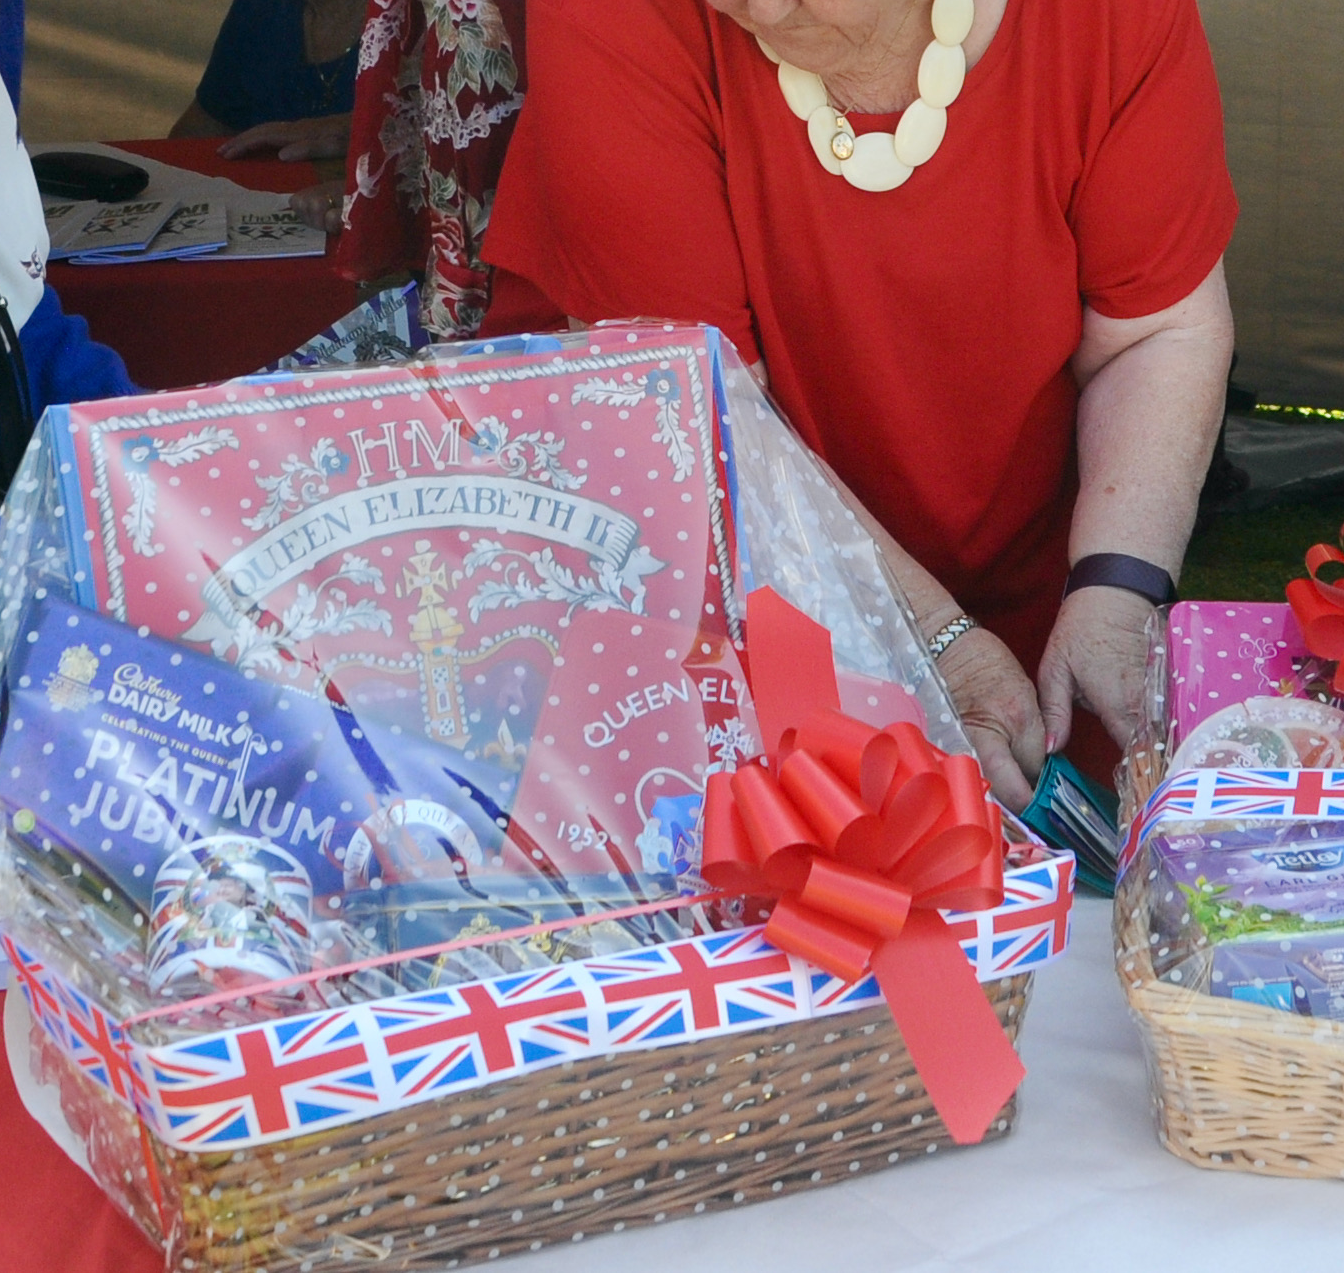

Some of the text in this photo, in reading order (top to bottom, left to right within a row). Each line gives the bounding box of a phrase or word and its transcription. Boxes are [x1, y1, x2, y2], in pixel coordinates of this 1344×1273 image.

[348, 418, 463, 478] HM
[230, 506, 354, 599] QUEEN
[363, 486, 576, 528] ELIZABETH
[113, 662, 182, 705] Cadbury
[583, 678, 689, 748] QUEEN
[107, 683, 233, 747] DAIRY MILK
[170, 739, 190, 753] THE
[85, 729, 337, 856] PLATINUM
[557, 820, 611, 851] 1952
[1272, 846, 1344, 866] Tetley
